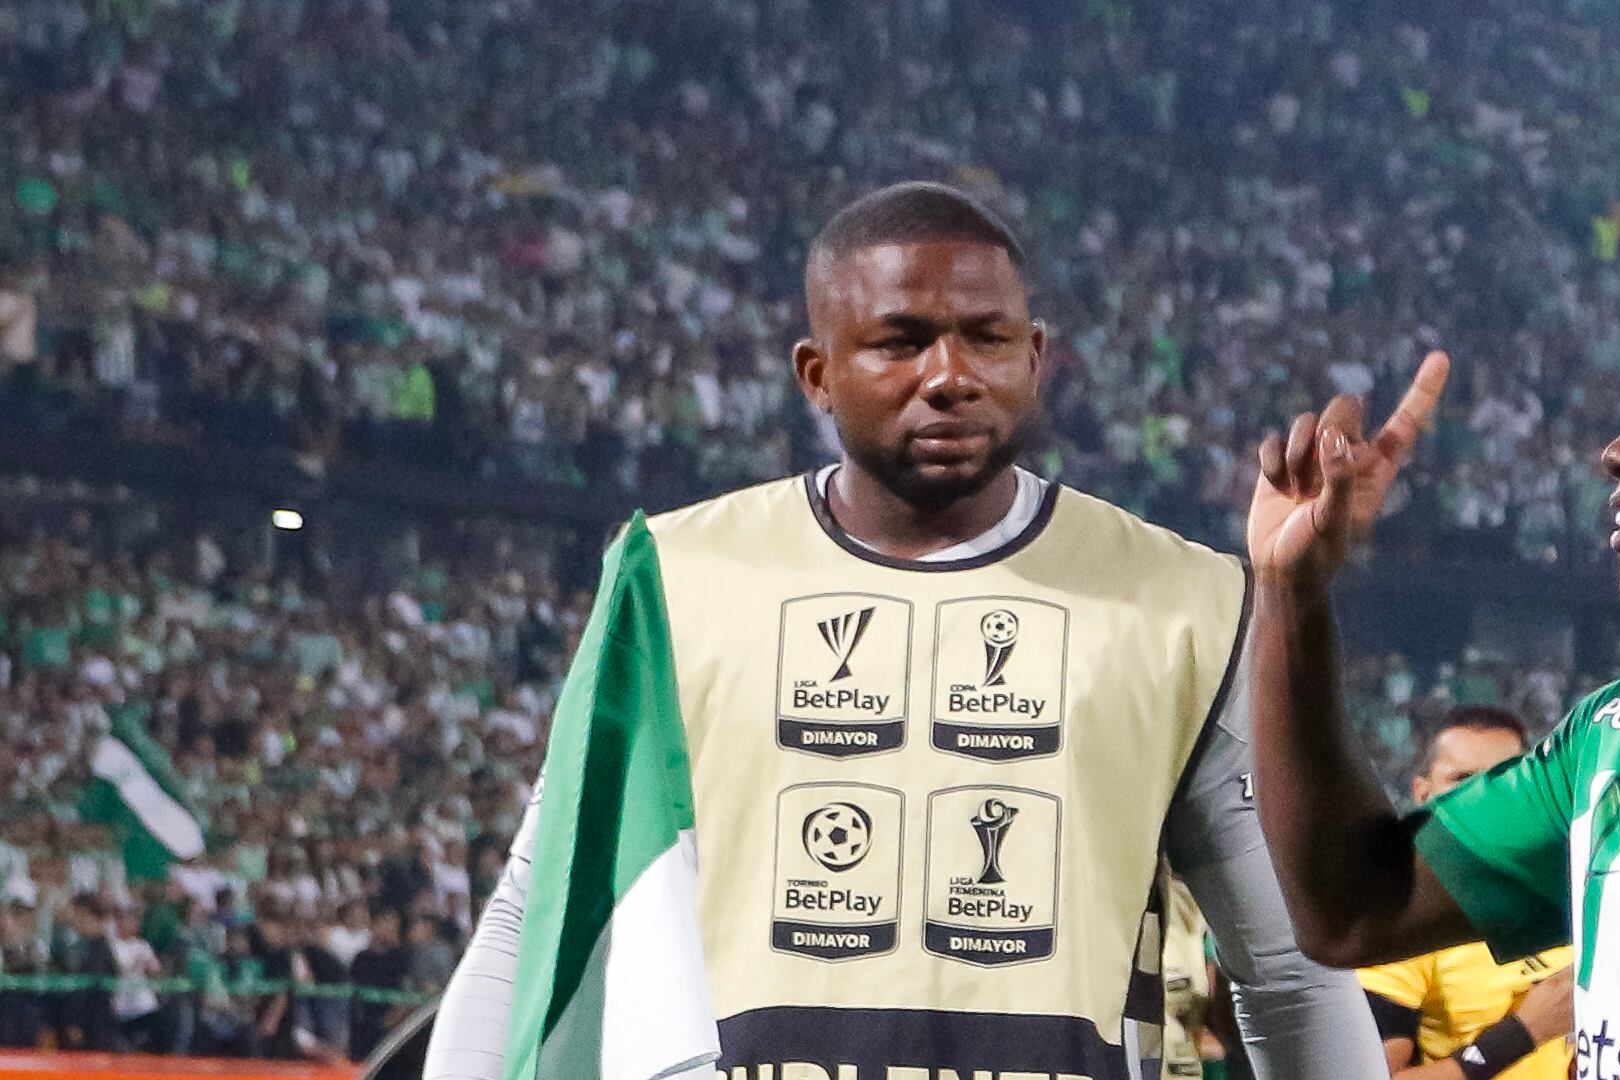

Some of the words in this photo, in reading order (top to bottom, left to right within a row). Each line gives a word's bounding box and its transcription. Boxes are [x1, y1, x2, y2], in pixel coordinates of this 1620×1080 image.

[793, 689, 890, 715] BetPlay
[949, 692, 1047, 719] BetPlay
[801, 730, 878, 747] DIMAYOR
[956, 732, 1035, 750] DIMAYOR
[785, 889, 883, 916] BetPlay
[948, 898, 1033, 923] BetPlay
[792, 932, 871, 949] DIMAYOR
[950, 937, 1027, 954] DIMAYOR
